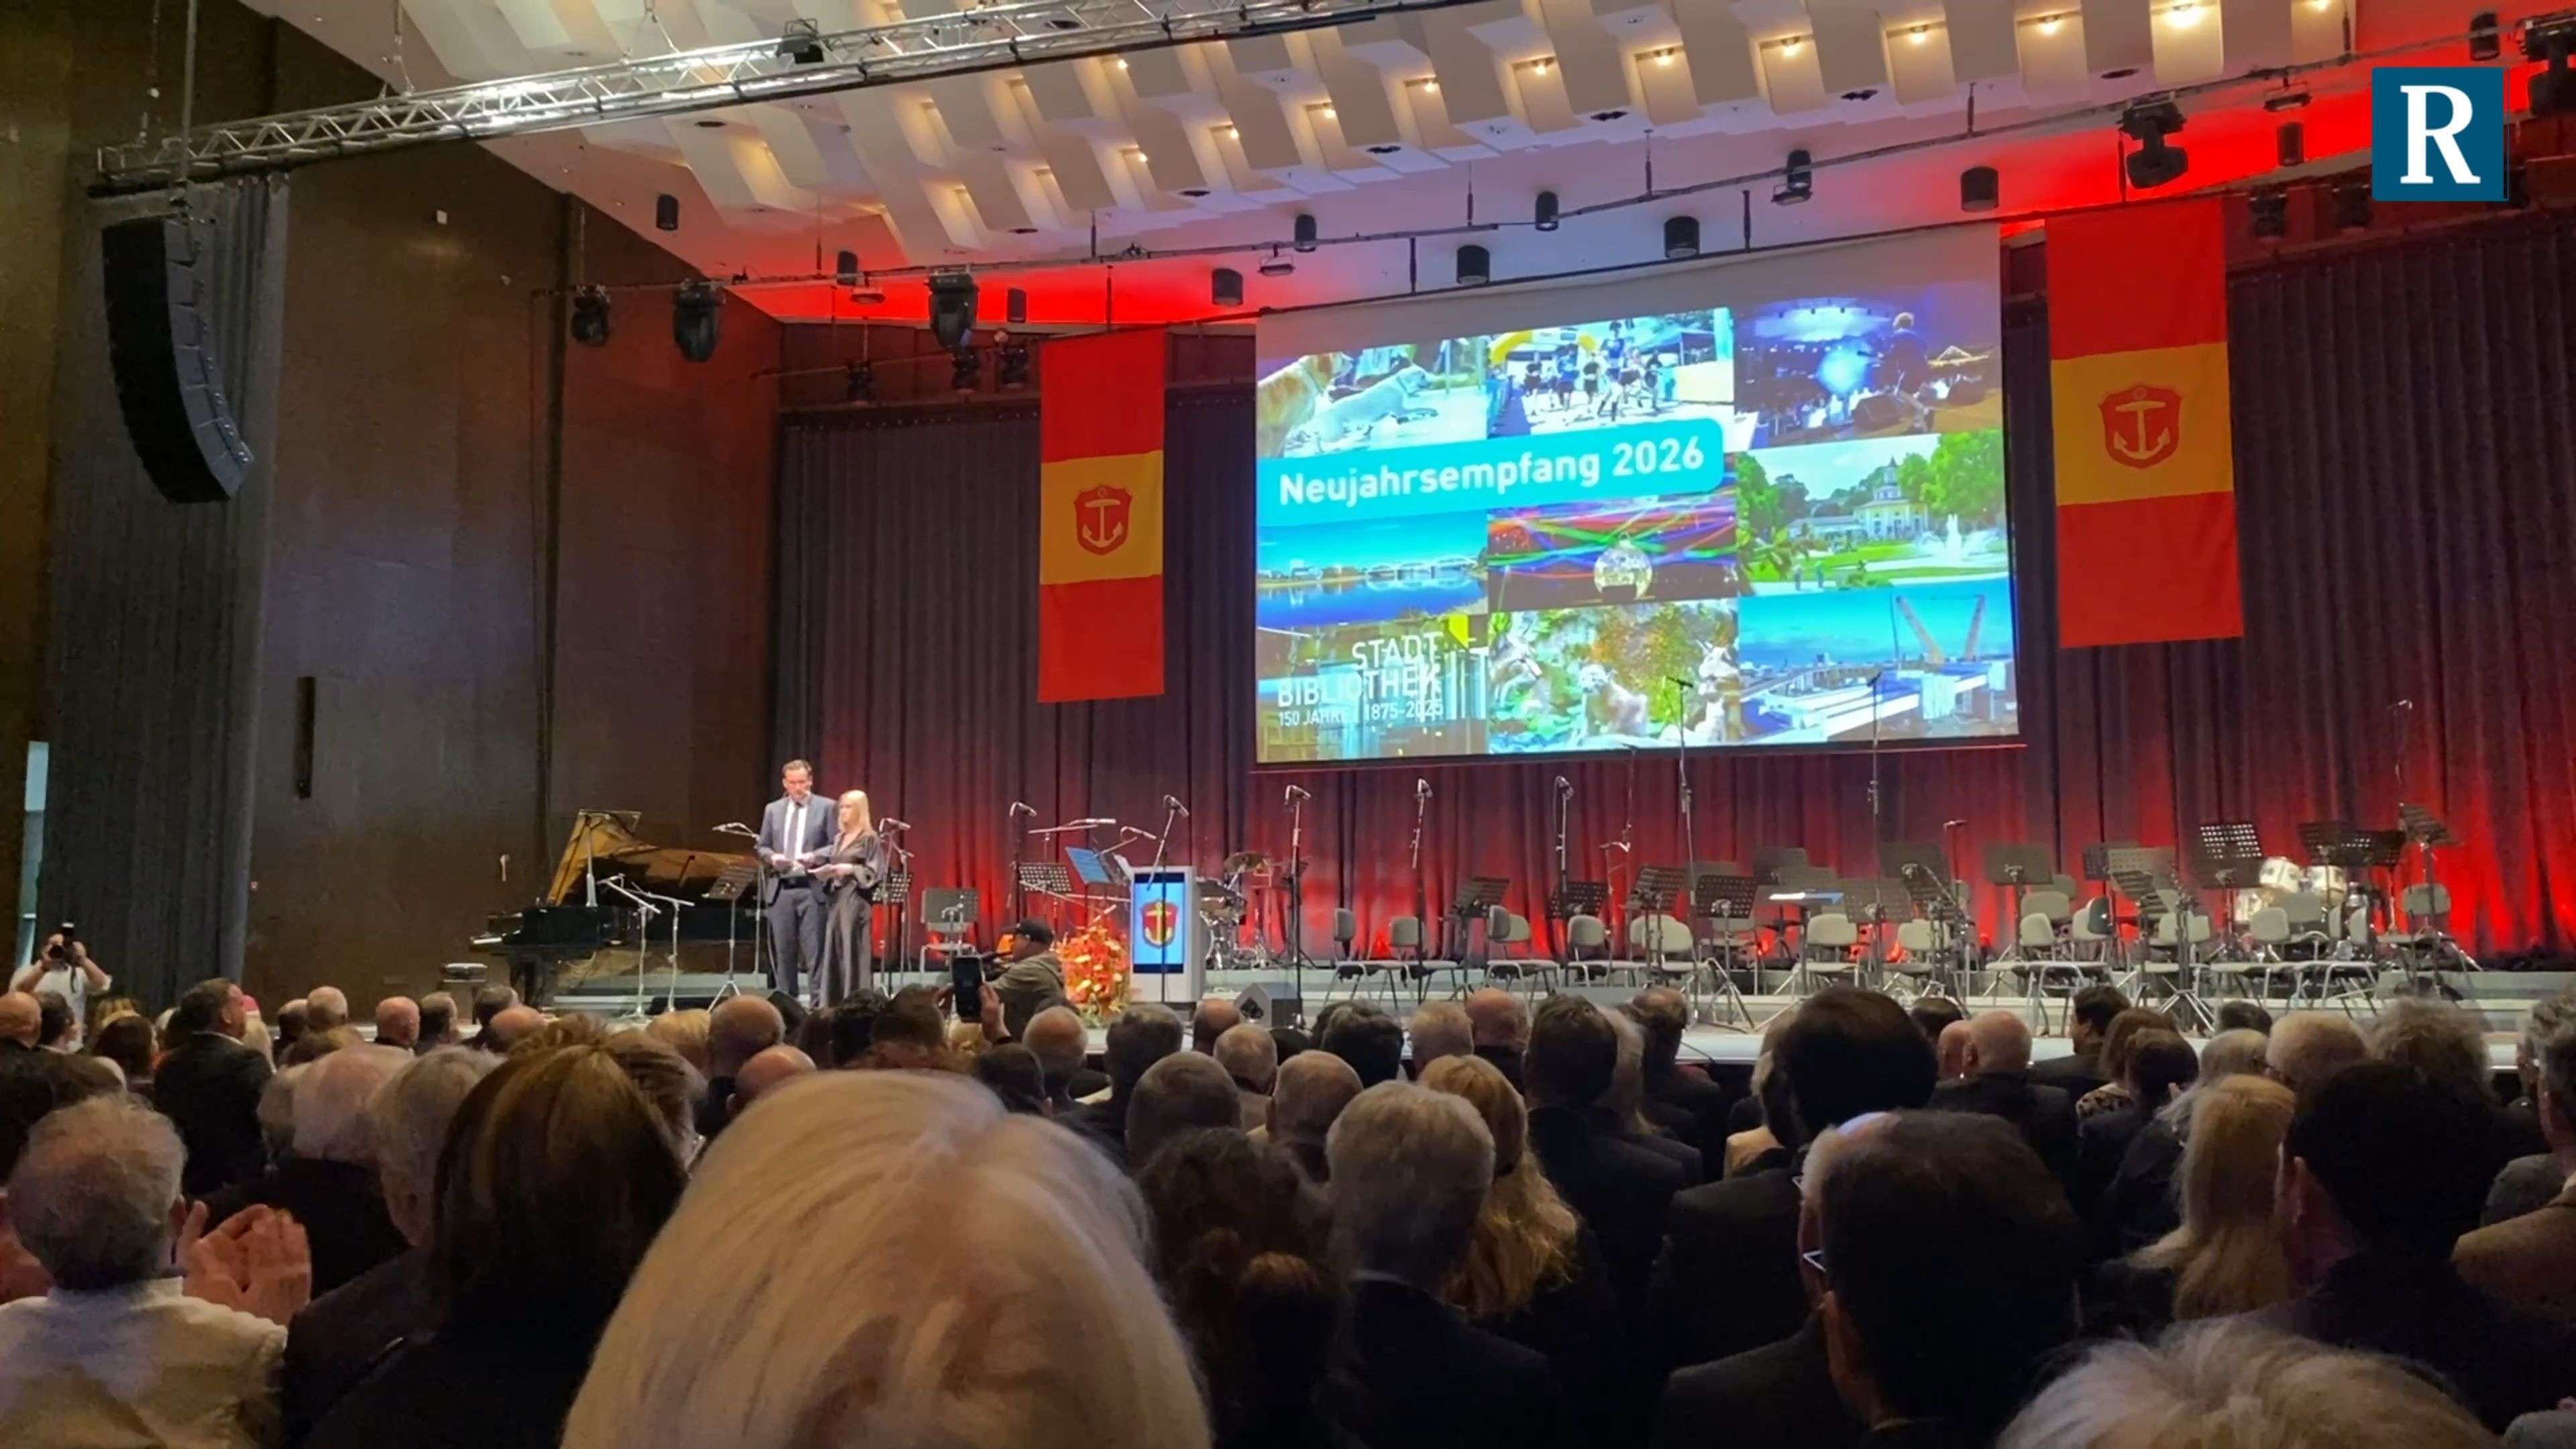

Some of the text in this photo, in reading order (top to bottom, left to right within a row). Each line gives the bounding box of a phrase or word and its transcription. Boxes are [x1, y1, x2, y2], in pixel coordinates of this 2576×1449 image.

[1279, 435, 1705, 506] Neujahrsempfang 2026
[1352, 631, 1444, 670] STADT
[1279, 710, 1300, 727] 150
